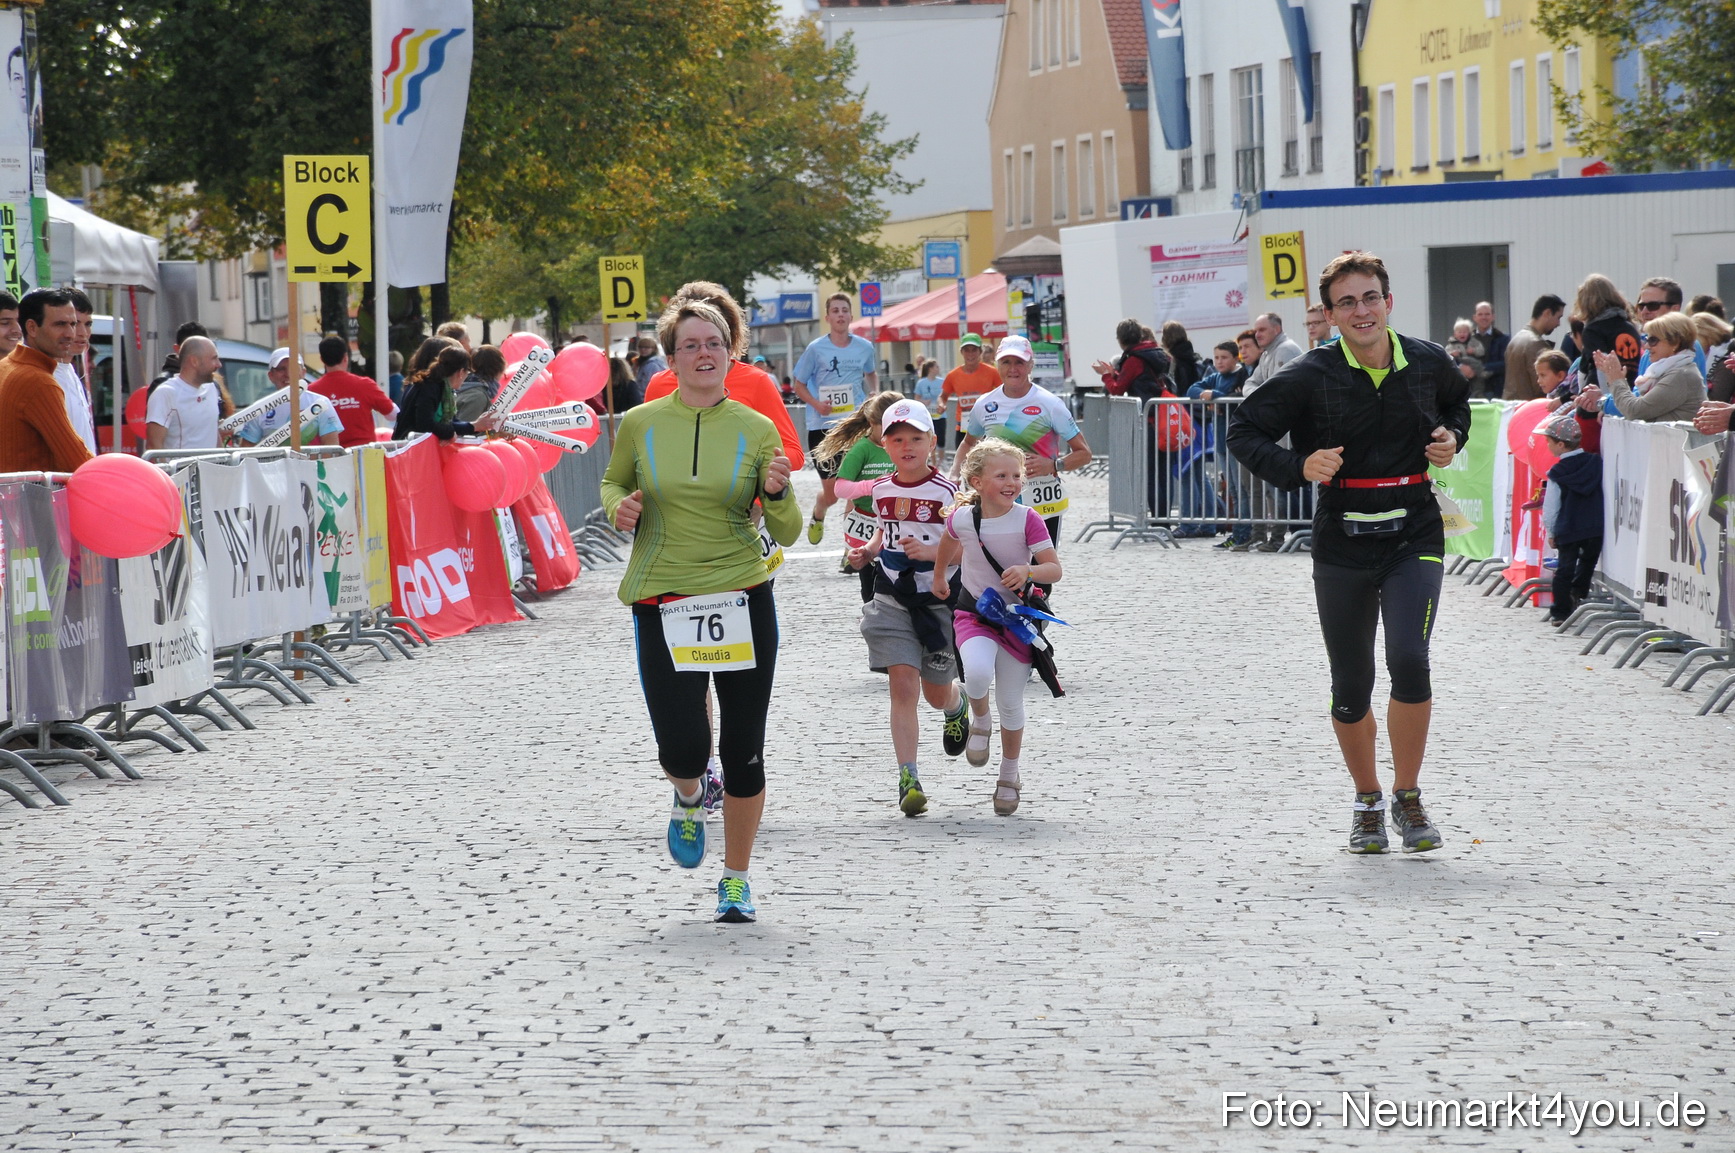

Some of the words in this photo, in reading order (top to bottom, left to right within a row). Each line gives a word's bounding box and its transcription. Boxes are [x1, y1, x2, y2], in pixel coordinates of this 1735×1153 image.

[1420, 28, 1452, 63] HOTEL
[295, 161, 360, 183] Block
[306, 193, 350, 255] C
[1265, 235, 1300, 249] Block
[605, 259, 639, 271] Block
[1273, 252, 1297, 285] D
[1171, 271, 1218, 284] DAHMIT
[612, 276, 635, 308] D
[862, 306, 880, 314] TAXI
[827, 392, 849, 405] 150
[1032, 483, 1062, 504] 306
[693, 600, 733, 612] Neumarkt
[689, 613, 725, 642] 76
[691, 649, 731, 662] Claudia
